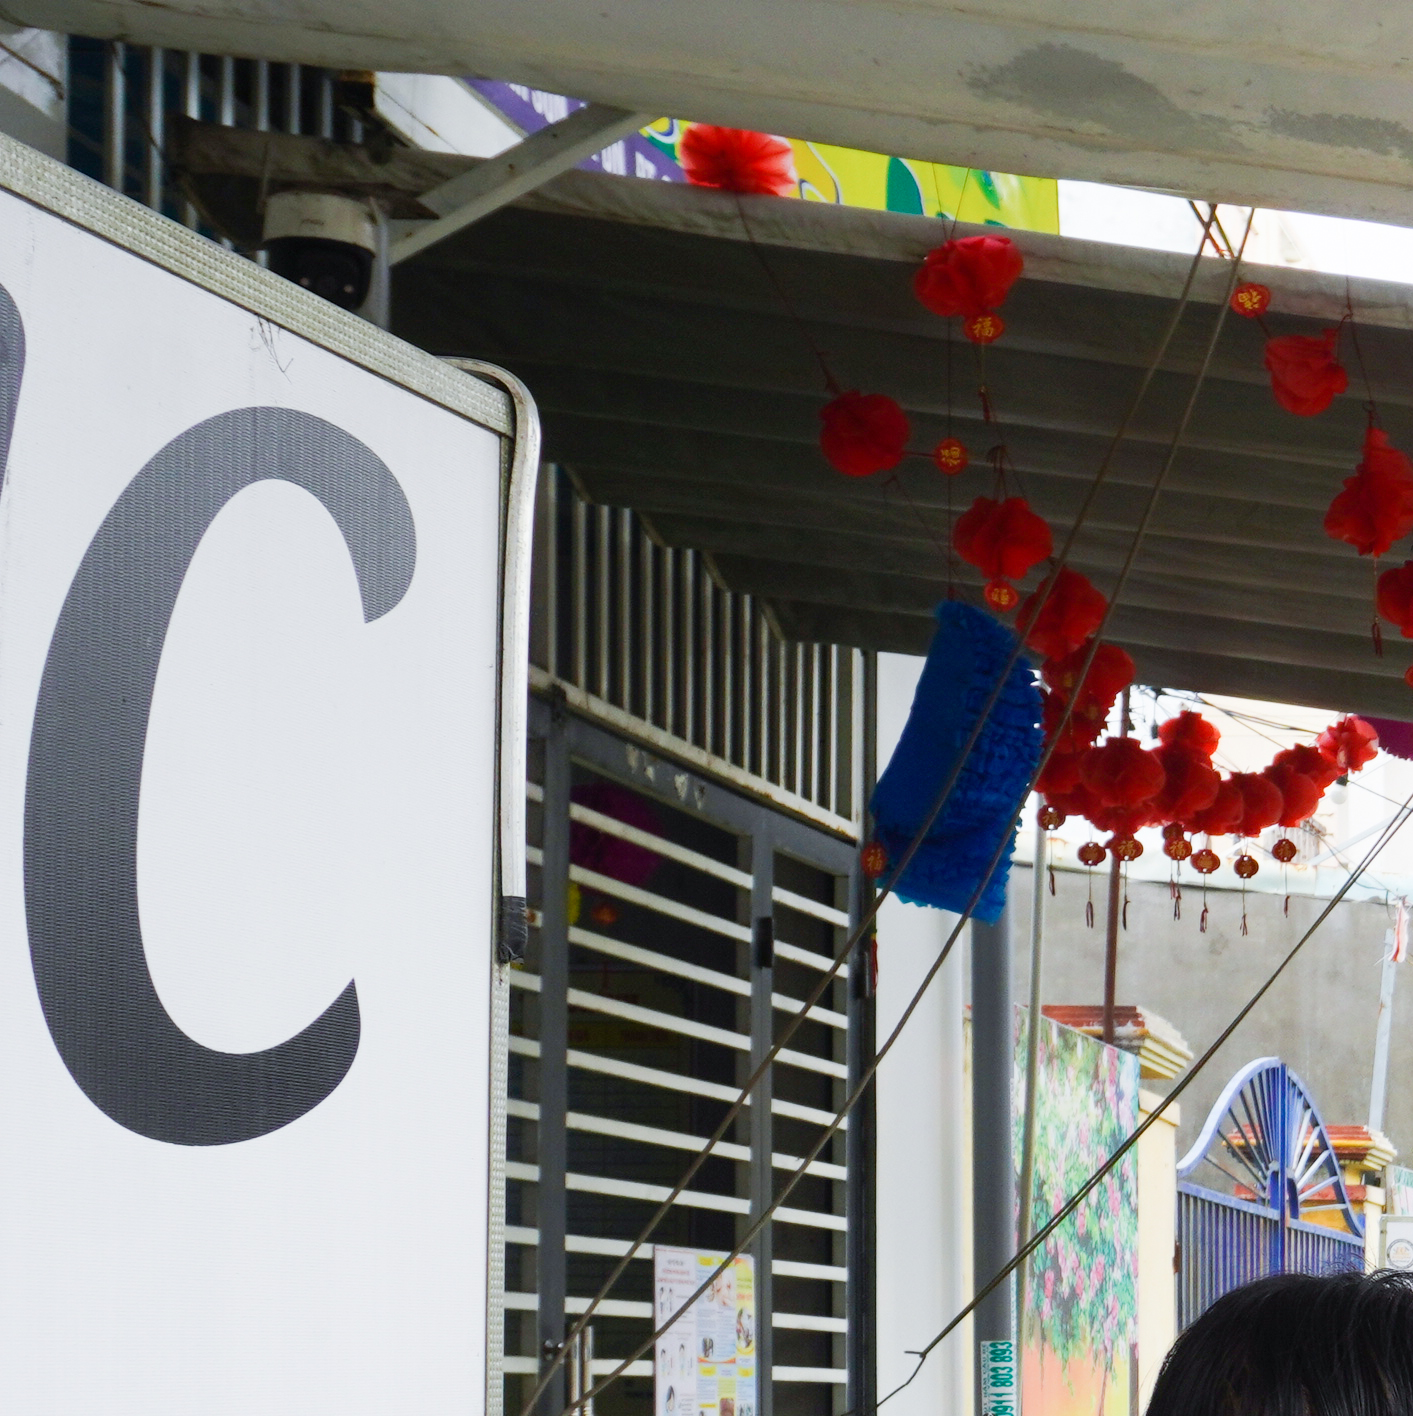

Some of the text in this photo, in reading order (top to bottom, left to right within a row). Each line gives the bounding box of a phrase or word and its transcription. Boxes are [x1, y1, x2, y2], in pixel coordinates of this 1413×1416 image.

[972, 316, 994, 338] 福
[989, 1341, 1013, 1363] 893
[989, 1366, 1013, 1388] 803
